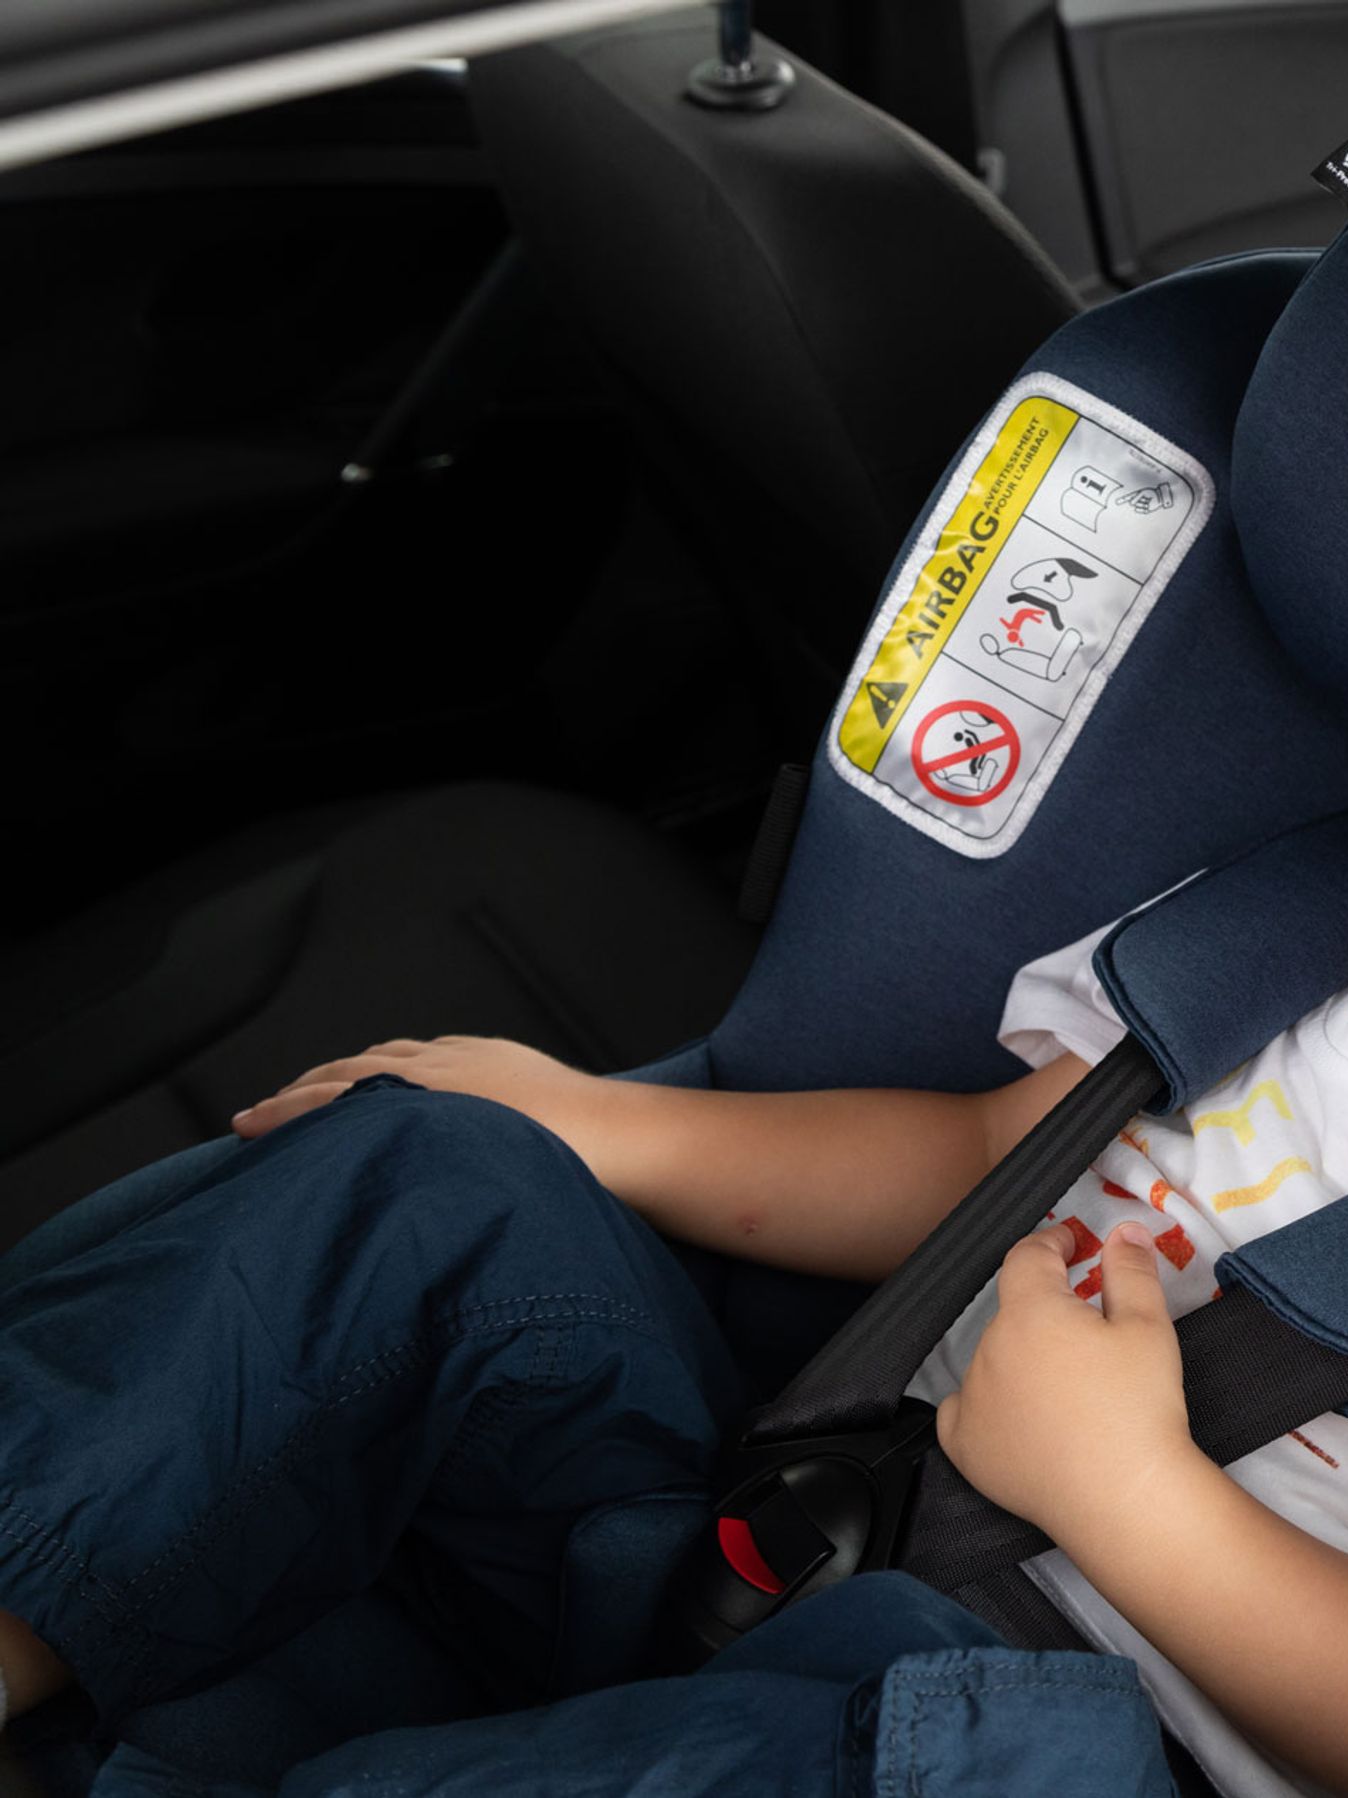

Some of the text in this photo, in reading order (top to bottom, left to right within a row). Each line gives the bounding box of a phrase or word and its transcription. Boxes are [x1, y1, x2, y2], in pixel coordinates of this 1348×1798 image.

[984, 416, 1040, 509] AVERTISSEMENT
[993, 428, 1049, 515] POUR L'AIRBAG
[906, 511, 1000, 660] AIRBAG
